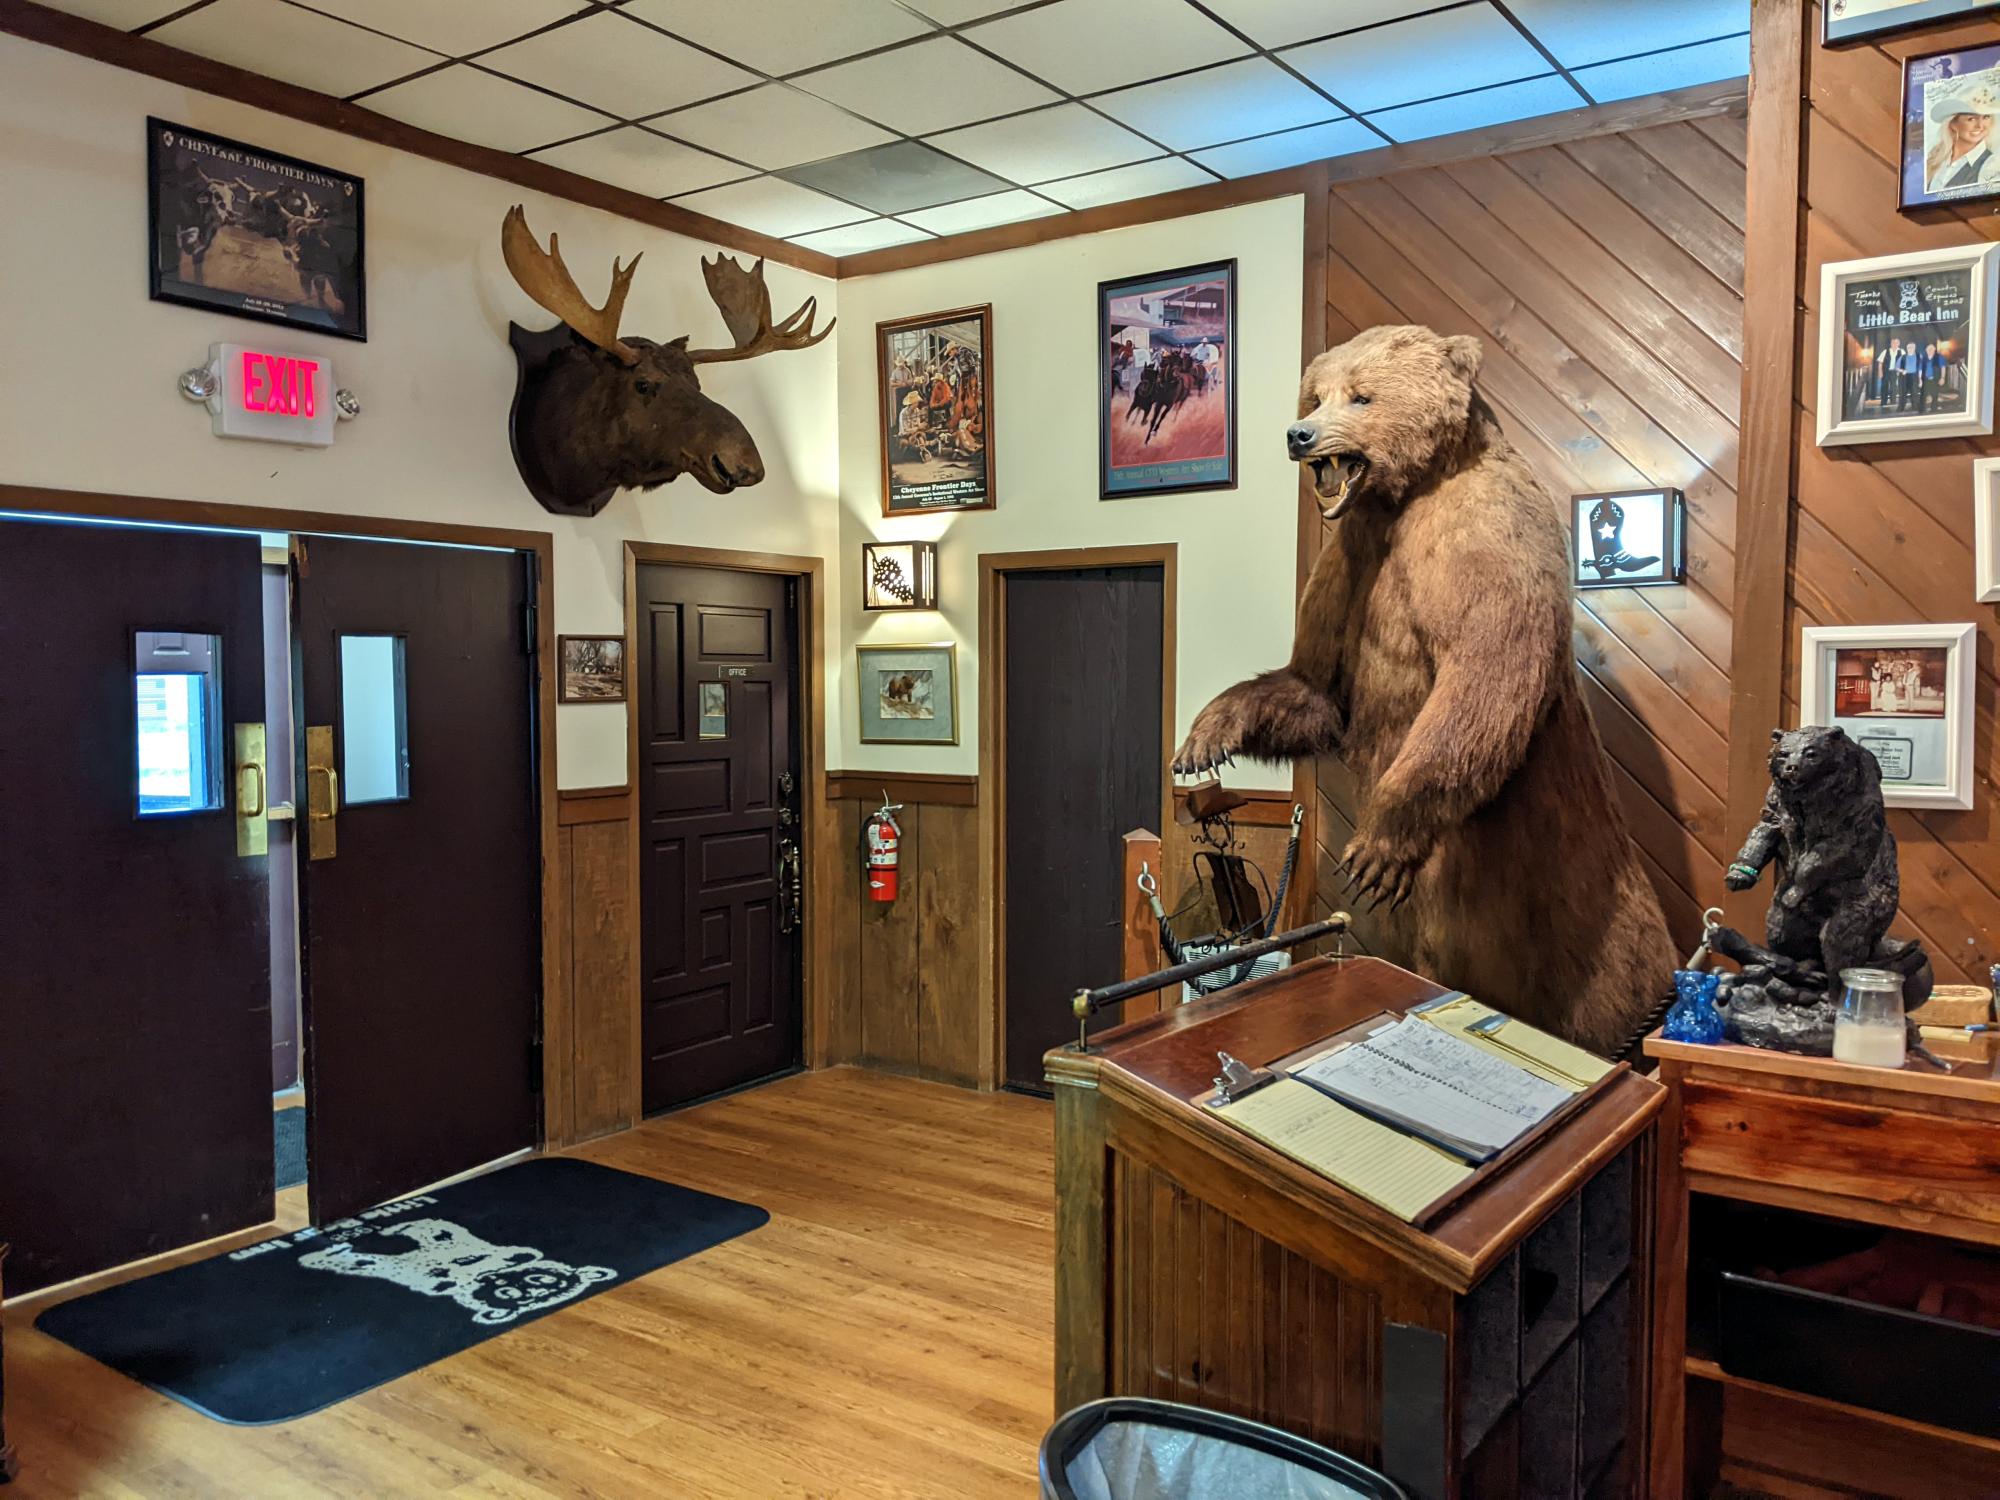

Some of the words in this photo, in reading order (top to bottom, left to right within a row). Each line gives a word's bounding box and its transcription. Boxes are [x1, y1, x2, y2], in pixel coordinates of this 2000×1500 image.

[179, 137, 243, 164] CHEYENNE
[245, 156, 304, 181] FRONTIER
[306, 173, 335, 188] DAYS
[1859, 311, 1894, 327] Little
[1900, 310, 1931, 323] Bear
[1937, 307, 1958, 320] Inn
[243, 352, 319, 418] EXIT
[901, 486, 931, 494] Cheyenne
[932, 482, 959, 490] Frontier
[728, 668, 747, 676] OFFICE
